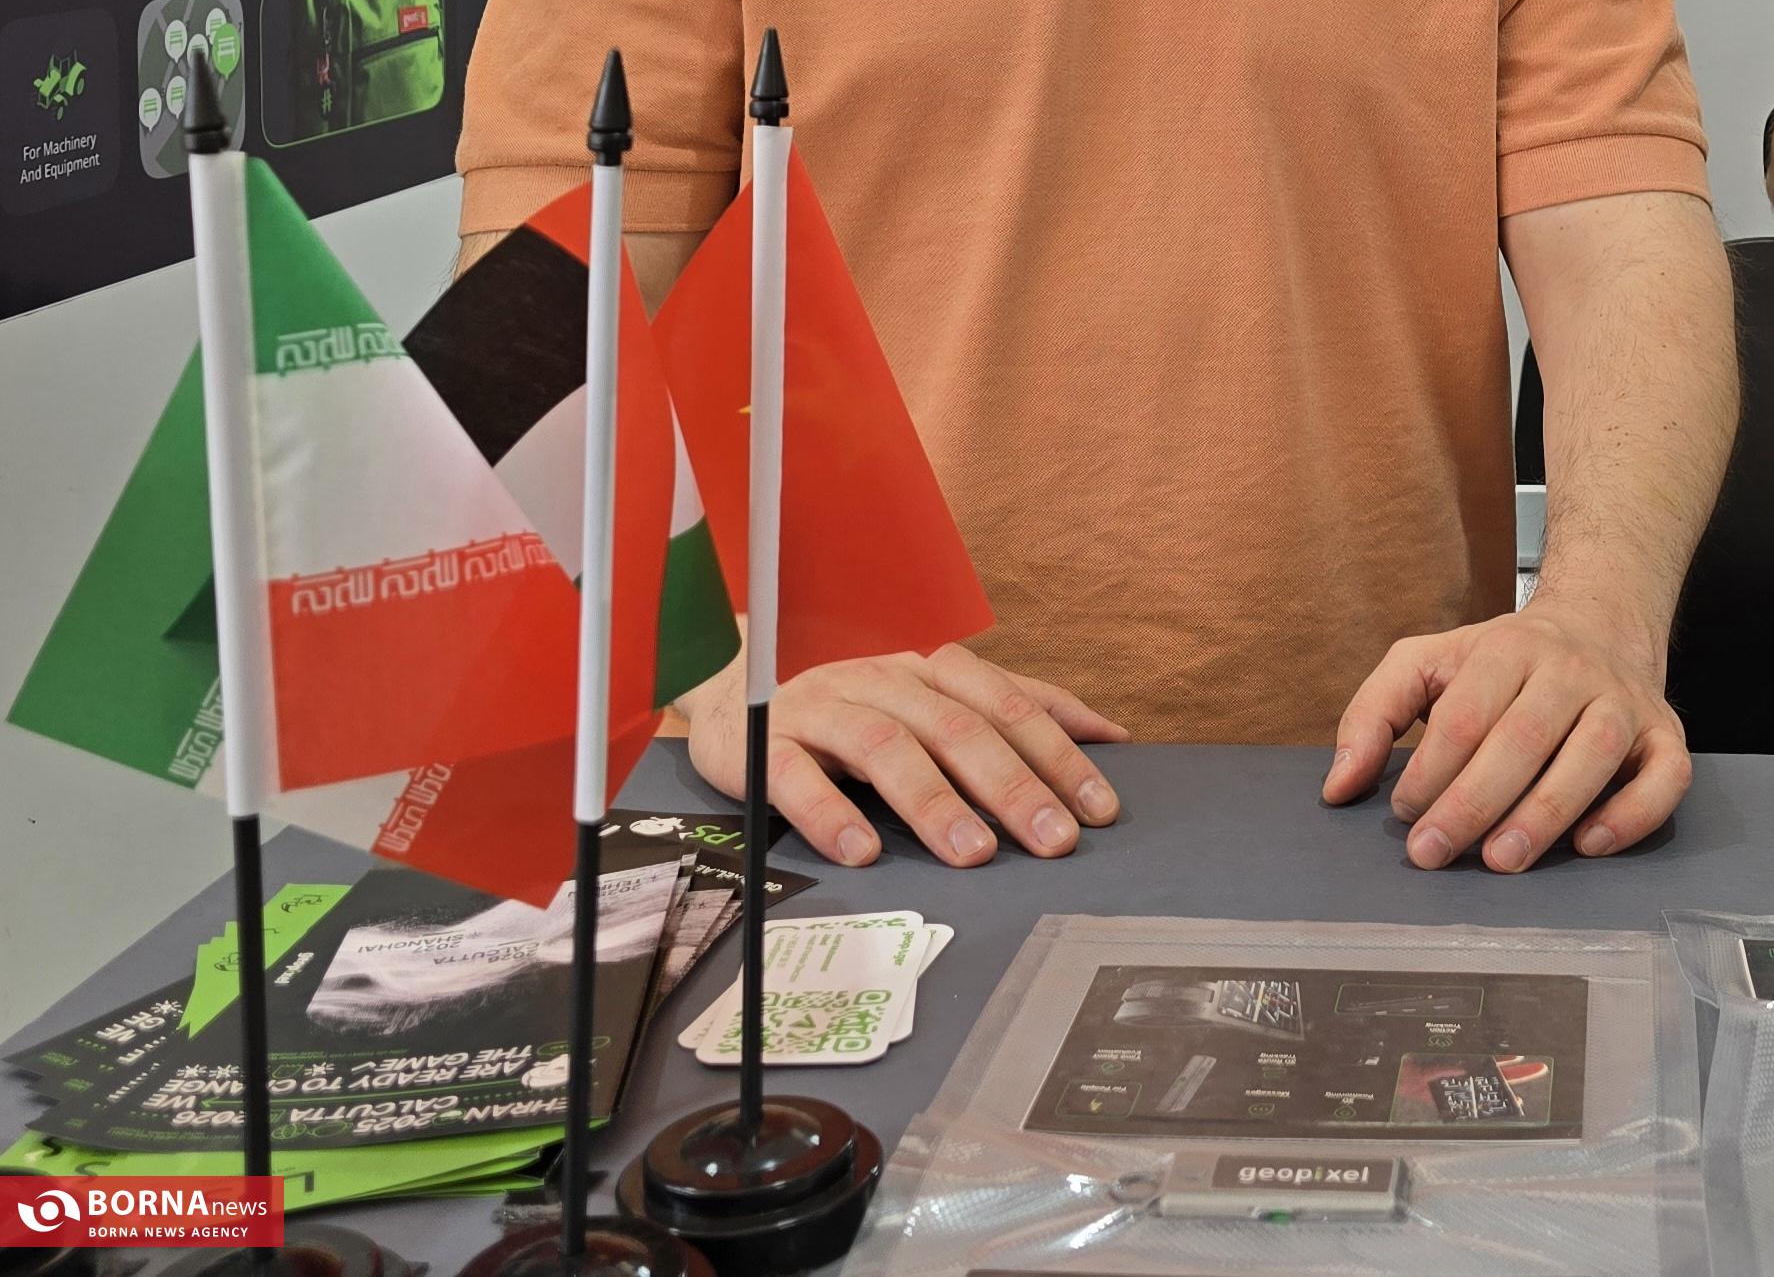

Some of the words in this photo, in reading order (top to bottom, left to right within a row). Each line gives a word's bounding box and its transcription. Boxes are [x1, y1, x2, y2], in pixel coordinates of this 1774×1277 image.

[23, 146, 42, 162] For
[43, 134, 97, 158] Machinery
[20, 164, 42, 185] And
[44, 153, 101, 180] Equipment
[357, 933, 465, 954] SHANGHAI
[433, 942, 541, 966] CALCUTTA
[374, 1052, 469, 1073] GAME
[471, 1045, 532, 1064] THE
[348, 1066, 458, 1090] READY
[458, 1059, 526, 1079] ARE
[158, 1078, 297, 1094] CANGE
[301, 1076, 343, 1092] TO
[141, 1093, 197, 1110] WE
[290, 1096, 459, 1122] CALCUTTA
[462, 1096, 570, 1122] EHRAN
[352, 1112, 436, 1134] 2025
[1239, 1166, 1369, 1186] geopixel
